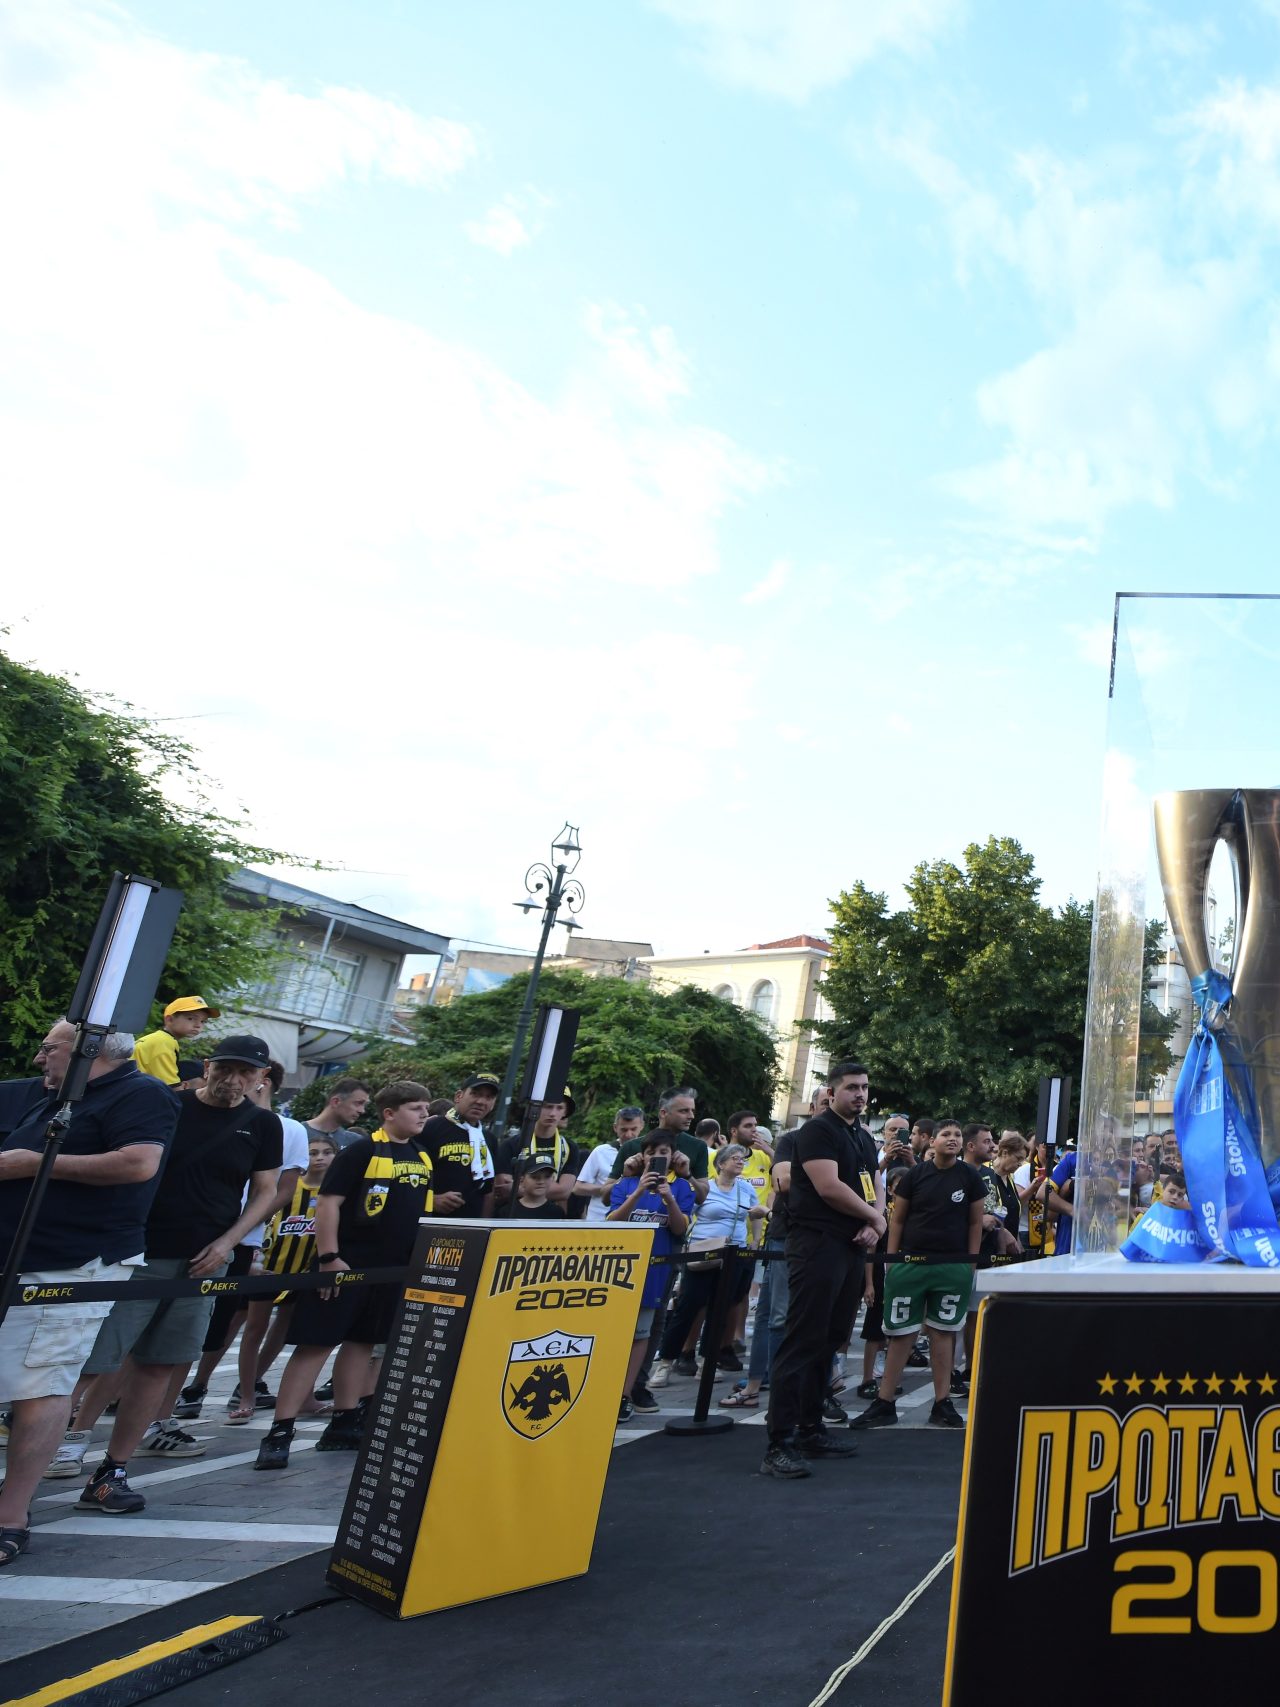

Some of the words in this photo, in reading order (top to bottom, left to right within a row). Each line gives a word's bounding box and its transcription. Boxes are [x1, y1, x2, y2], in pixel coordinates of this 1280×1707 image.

[344, 1274, 356, 1282] AEK
[356, 1273, 365, 1281] FC
[488, 1253, 641, 1299] ΠΡΩΤΑΘΛΗΤΕΣ
[38, 1287, 60, 1298] AEK
[60, 1287, 74, 1297] FC
[211, 1282, 228, 1291] AEK
[228, 1281, 239, 1290] FC
[515, 1287, 609, 1311] 2026
[890, 1296, 911, 1324] G
[938, 1294, 961, 1320] S
